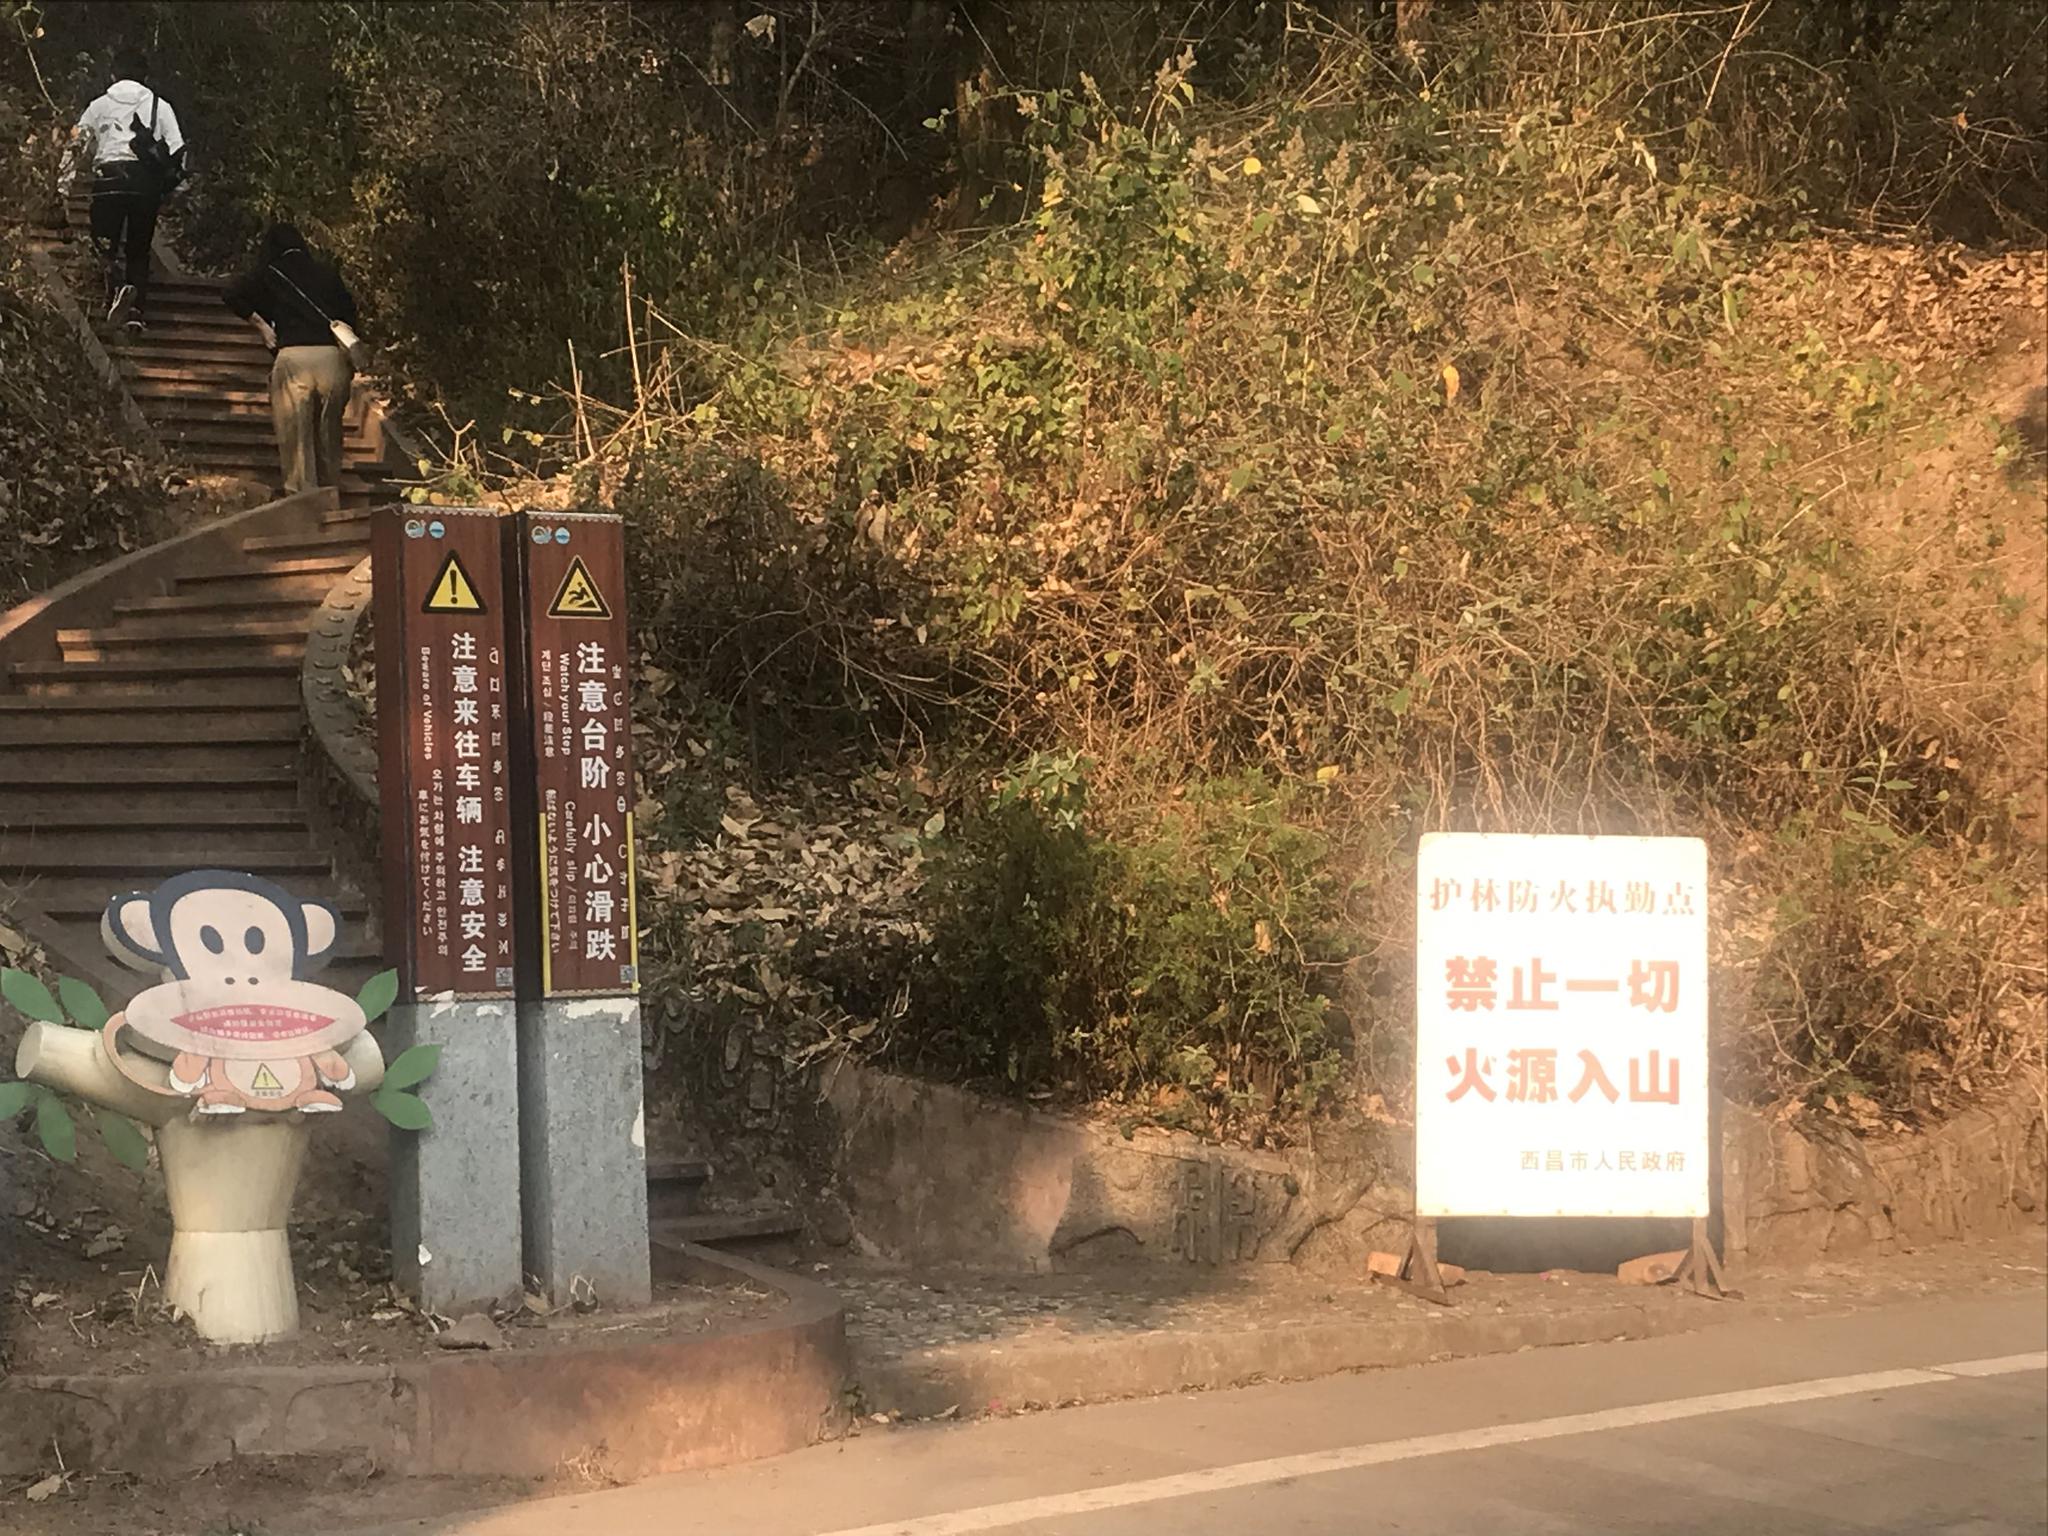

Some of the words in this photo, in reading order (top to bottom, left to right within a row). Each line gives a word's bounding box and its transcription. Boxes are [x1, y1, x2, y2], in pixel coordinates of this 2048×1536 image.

[421, 647, 430, 690] Beware
[560, 653, 570, 693] Watch
[451, 632, 482, 825] 注意来往车辆
[559, 695, 570, 724] your
[576, 642, 609, 789] 注意台阶
[423, 710, 434, 760] Vehicles
[561, 726, 572, 756] Step
[564, 801, 577, 854] Carefully
[566, 860, 577, 882] slip
[582, 813, 616, 961] 小心滑跌
[458, 844, 487, 973] 注意安全
[1429, 878, 1695, 915] 护林防火执勤点
[1445, 956, 1680, 1013] 禁止一切
[1445, 1047, 1680, 1104] 火源入山
[1520, 1150, 1686, 1172] 西昌市人民政府
